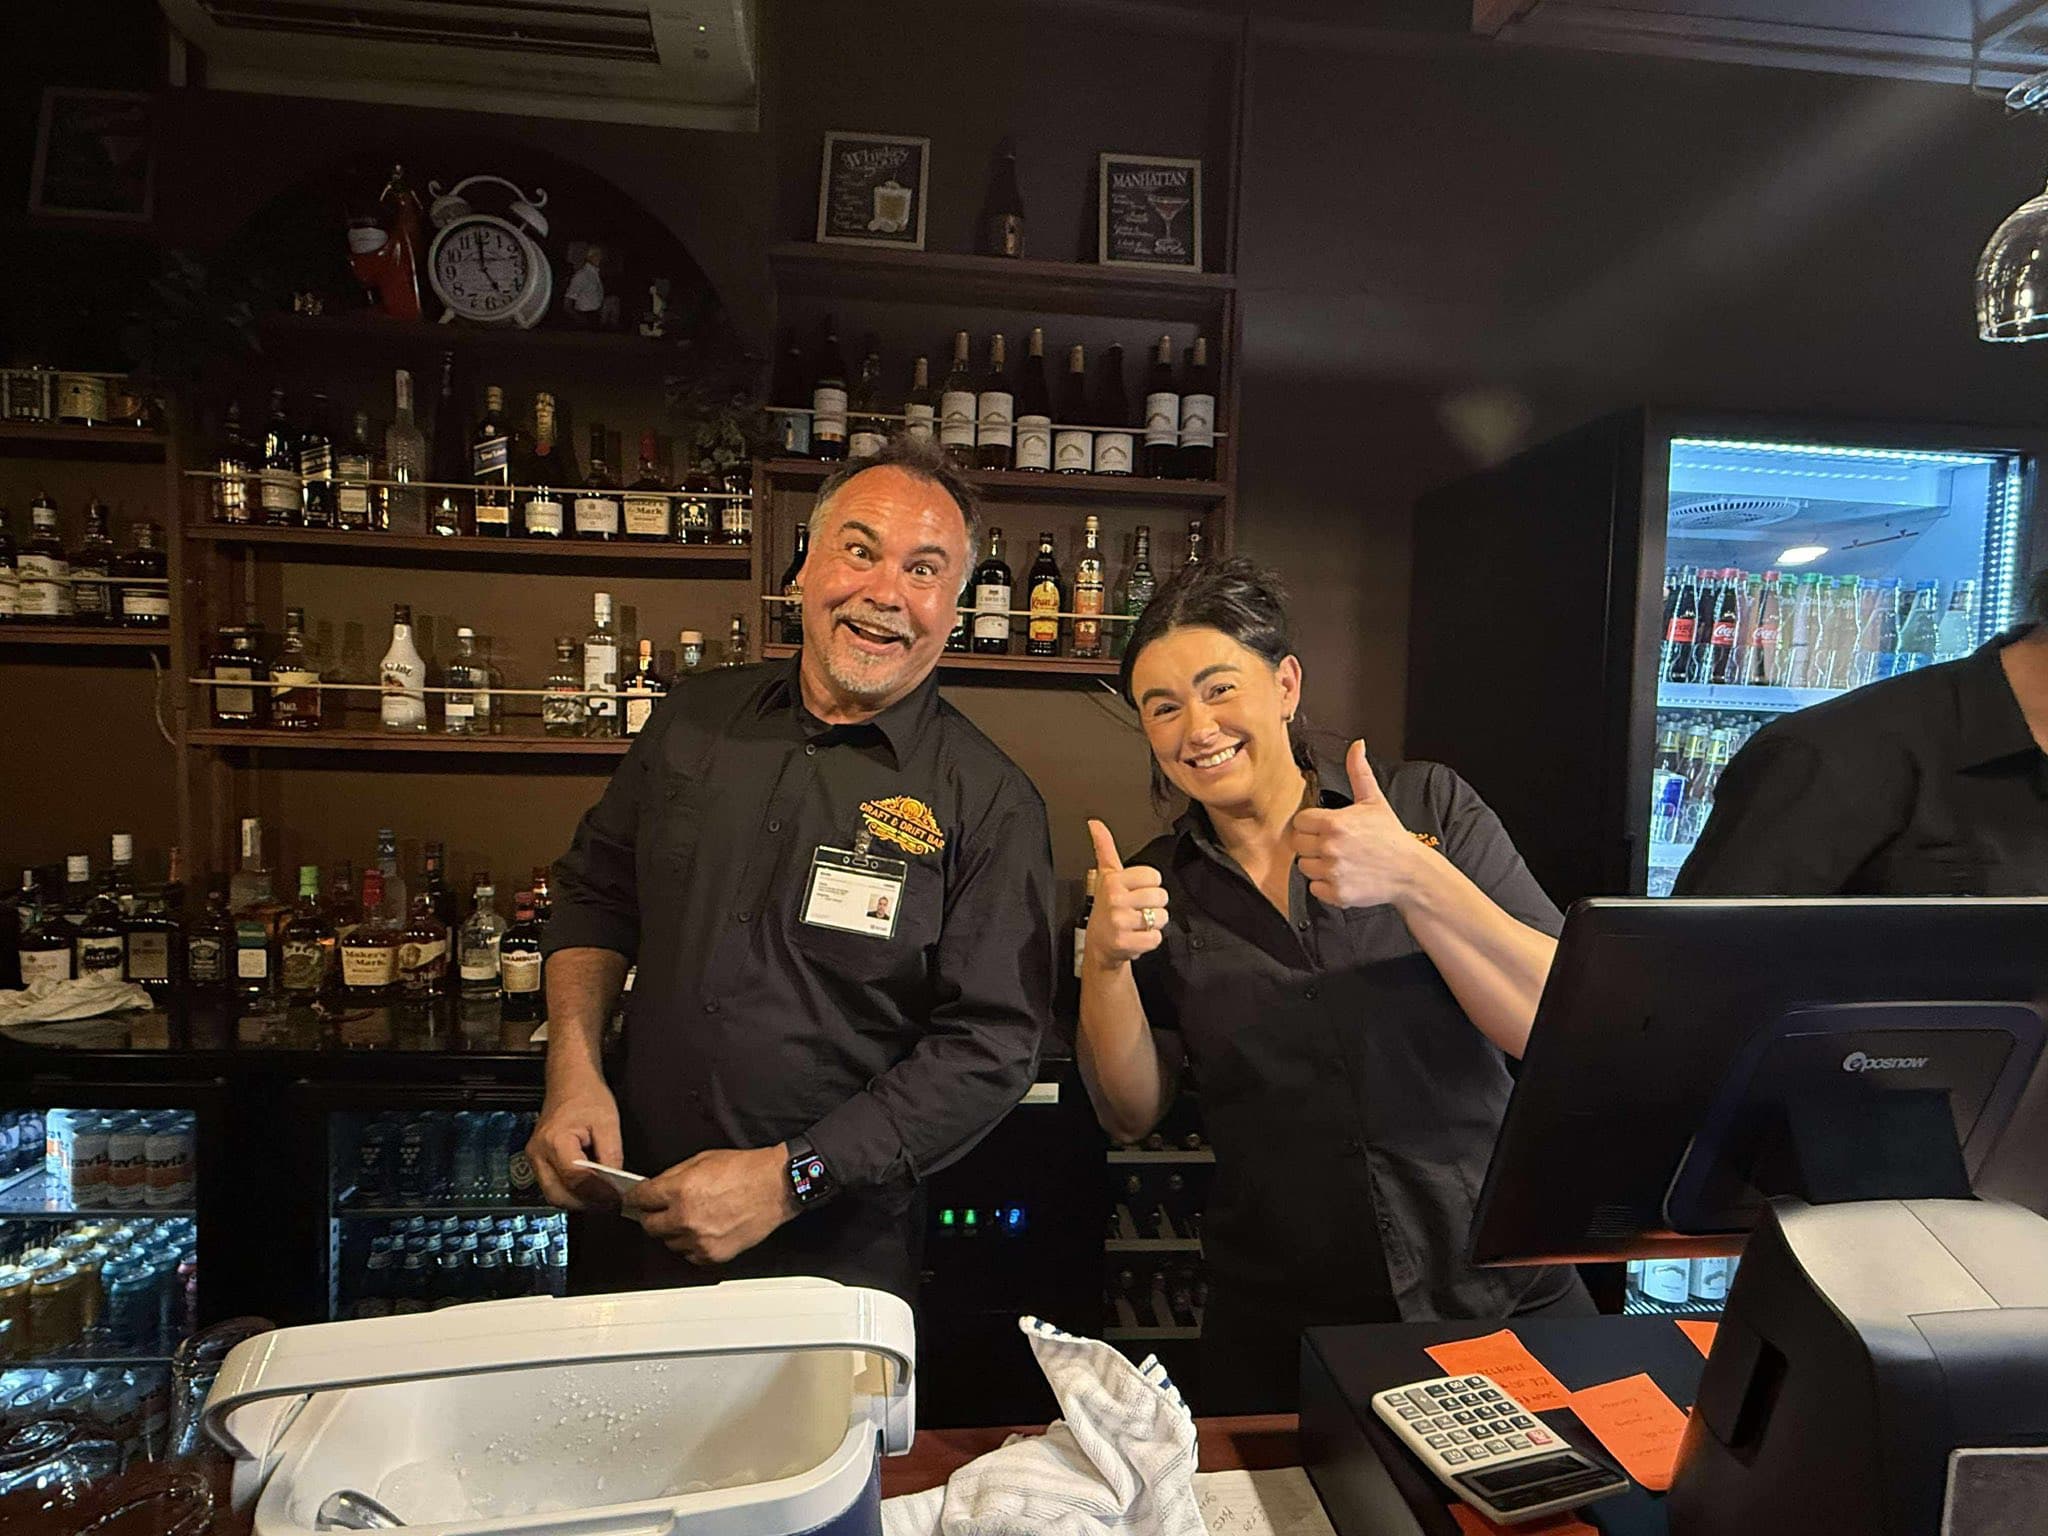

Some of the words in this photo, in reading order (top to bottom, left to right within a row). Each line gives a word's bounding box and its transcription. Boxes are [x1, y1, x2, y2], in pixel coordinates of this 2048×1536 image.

[1113, 171, 1187, 187] MANHATTAN
[859, 802, 890, 822] DRAFT
[899, 821, 928, 840] DRIFT
[926, 833, 945, 850] BAR
